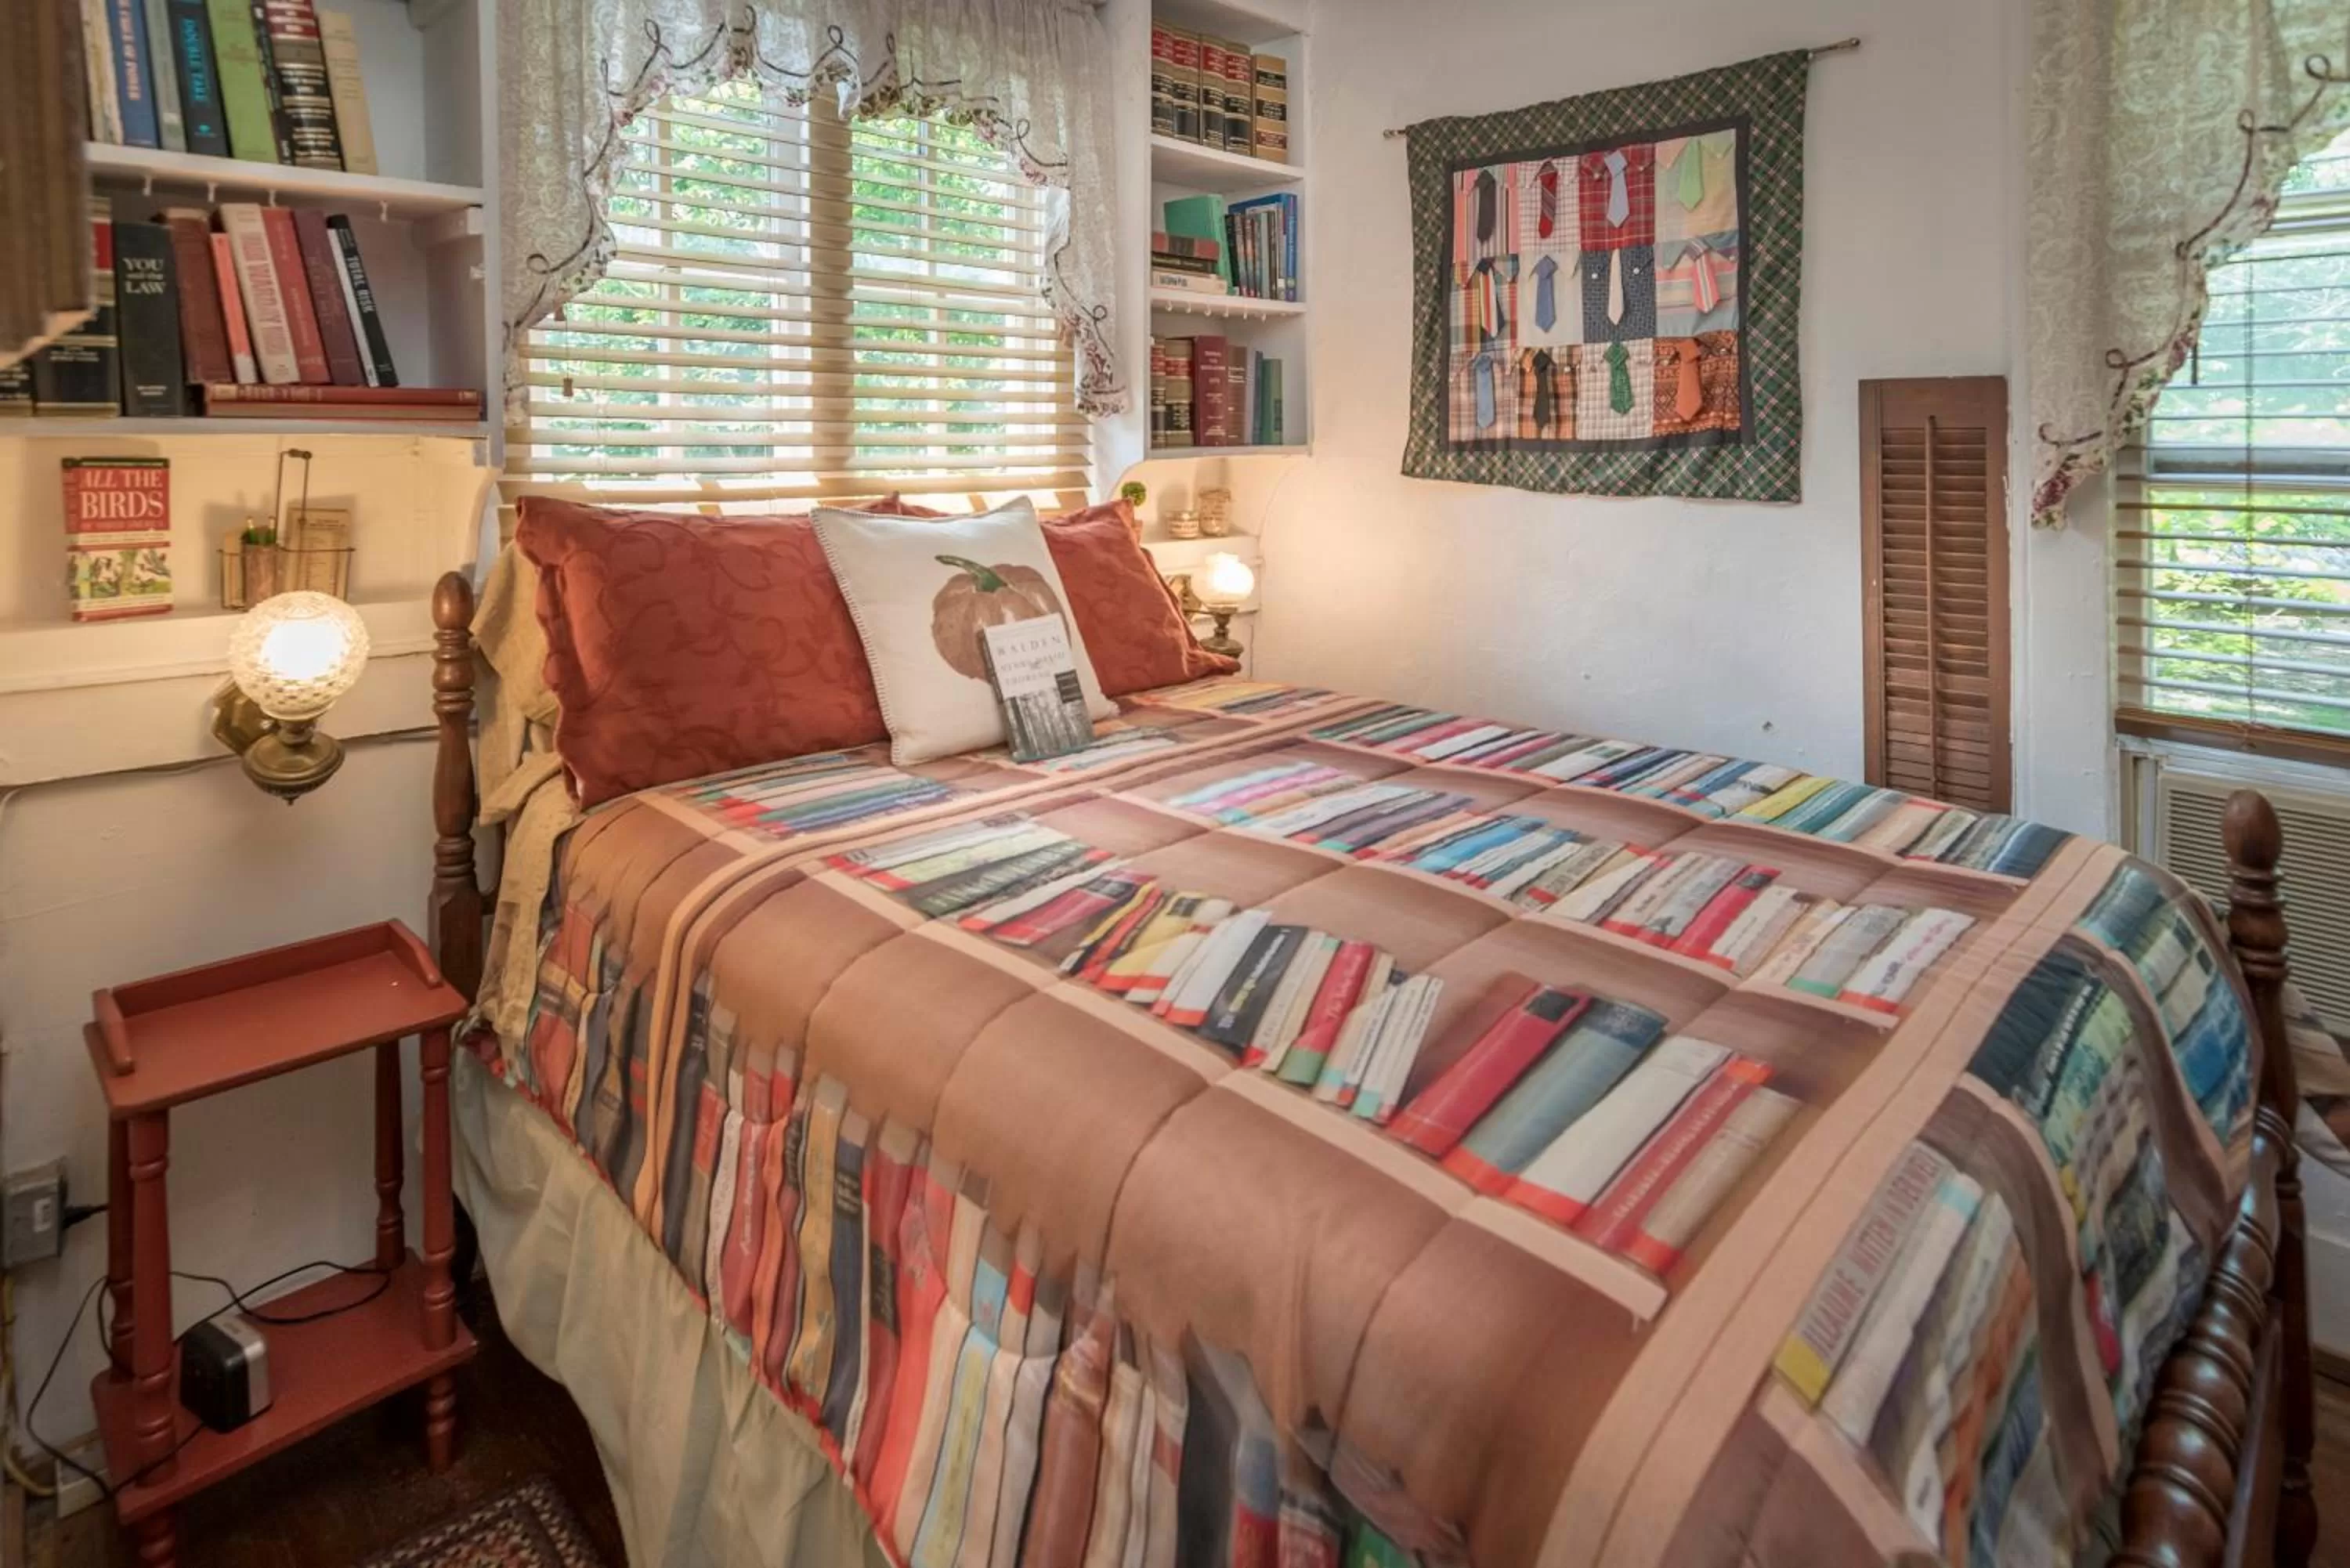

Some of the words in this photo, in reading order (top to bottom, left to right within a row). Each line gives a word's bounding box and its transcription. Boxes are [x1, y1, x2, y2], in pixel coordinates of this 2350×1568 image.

[122, 258, 164, 271] YOU
[125, 281, 166, 294] LAW
[347, 255, 367, 286] TOTAL
[357, 288, 377, 313] RISK
[81, 471, 117, 488] ALL
[120, 470, 164, 488] THE
[80, 490, 164, 519] BIRDS
[996, 635, 1061, 656] WALDEN
